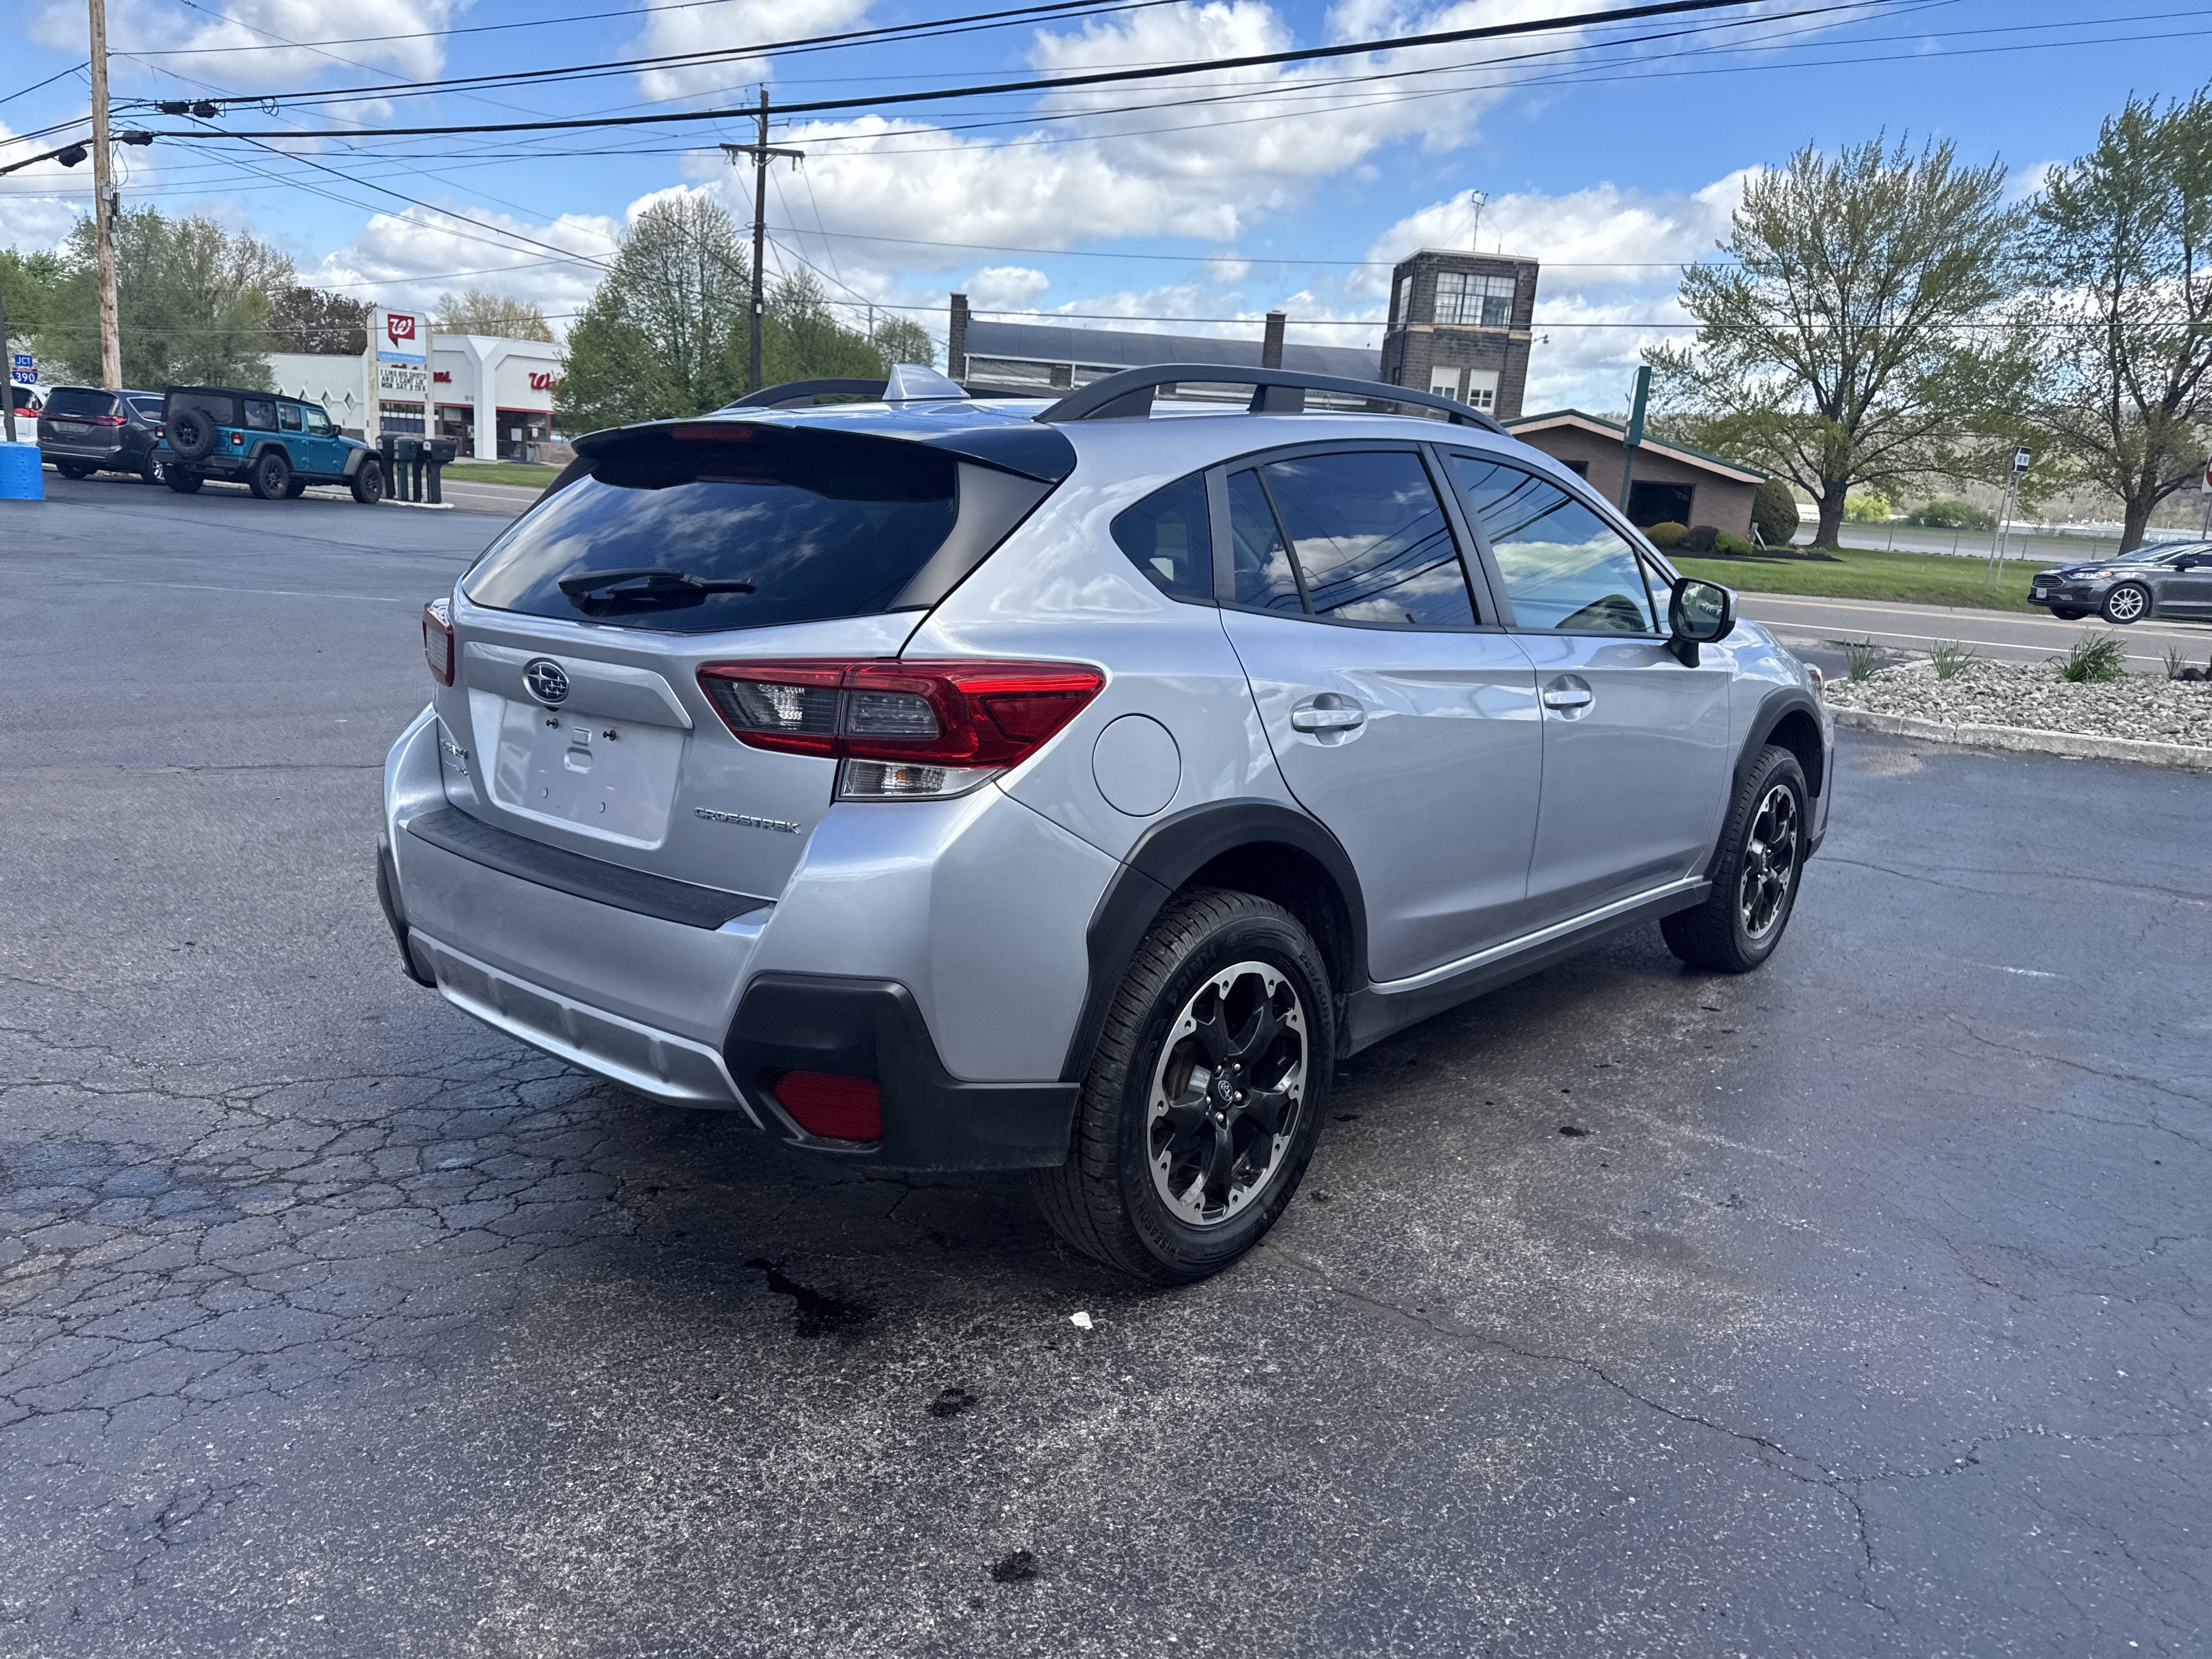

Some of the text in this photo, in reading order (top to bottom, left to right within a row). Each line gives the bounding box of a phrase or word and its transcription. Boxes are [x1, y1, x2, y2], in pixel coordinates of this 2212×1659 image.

[16, 357, 31, 365] JCT
[15, 372, 35, 382] 390
[693, 807, 801, 834] CROSSTREK
